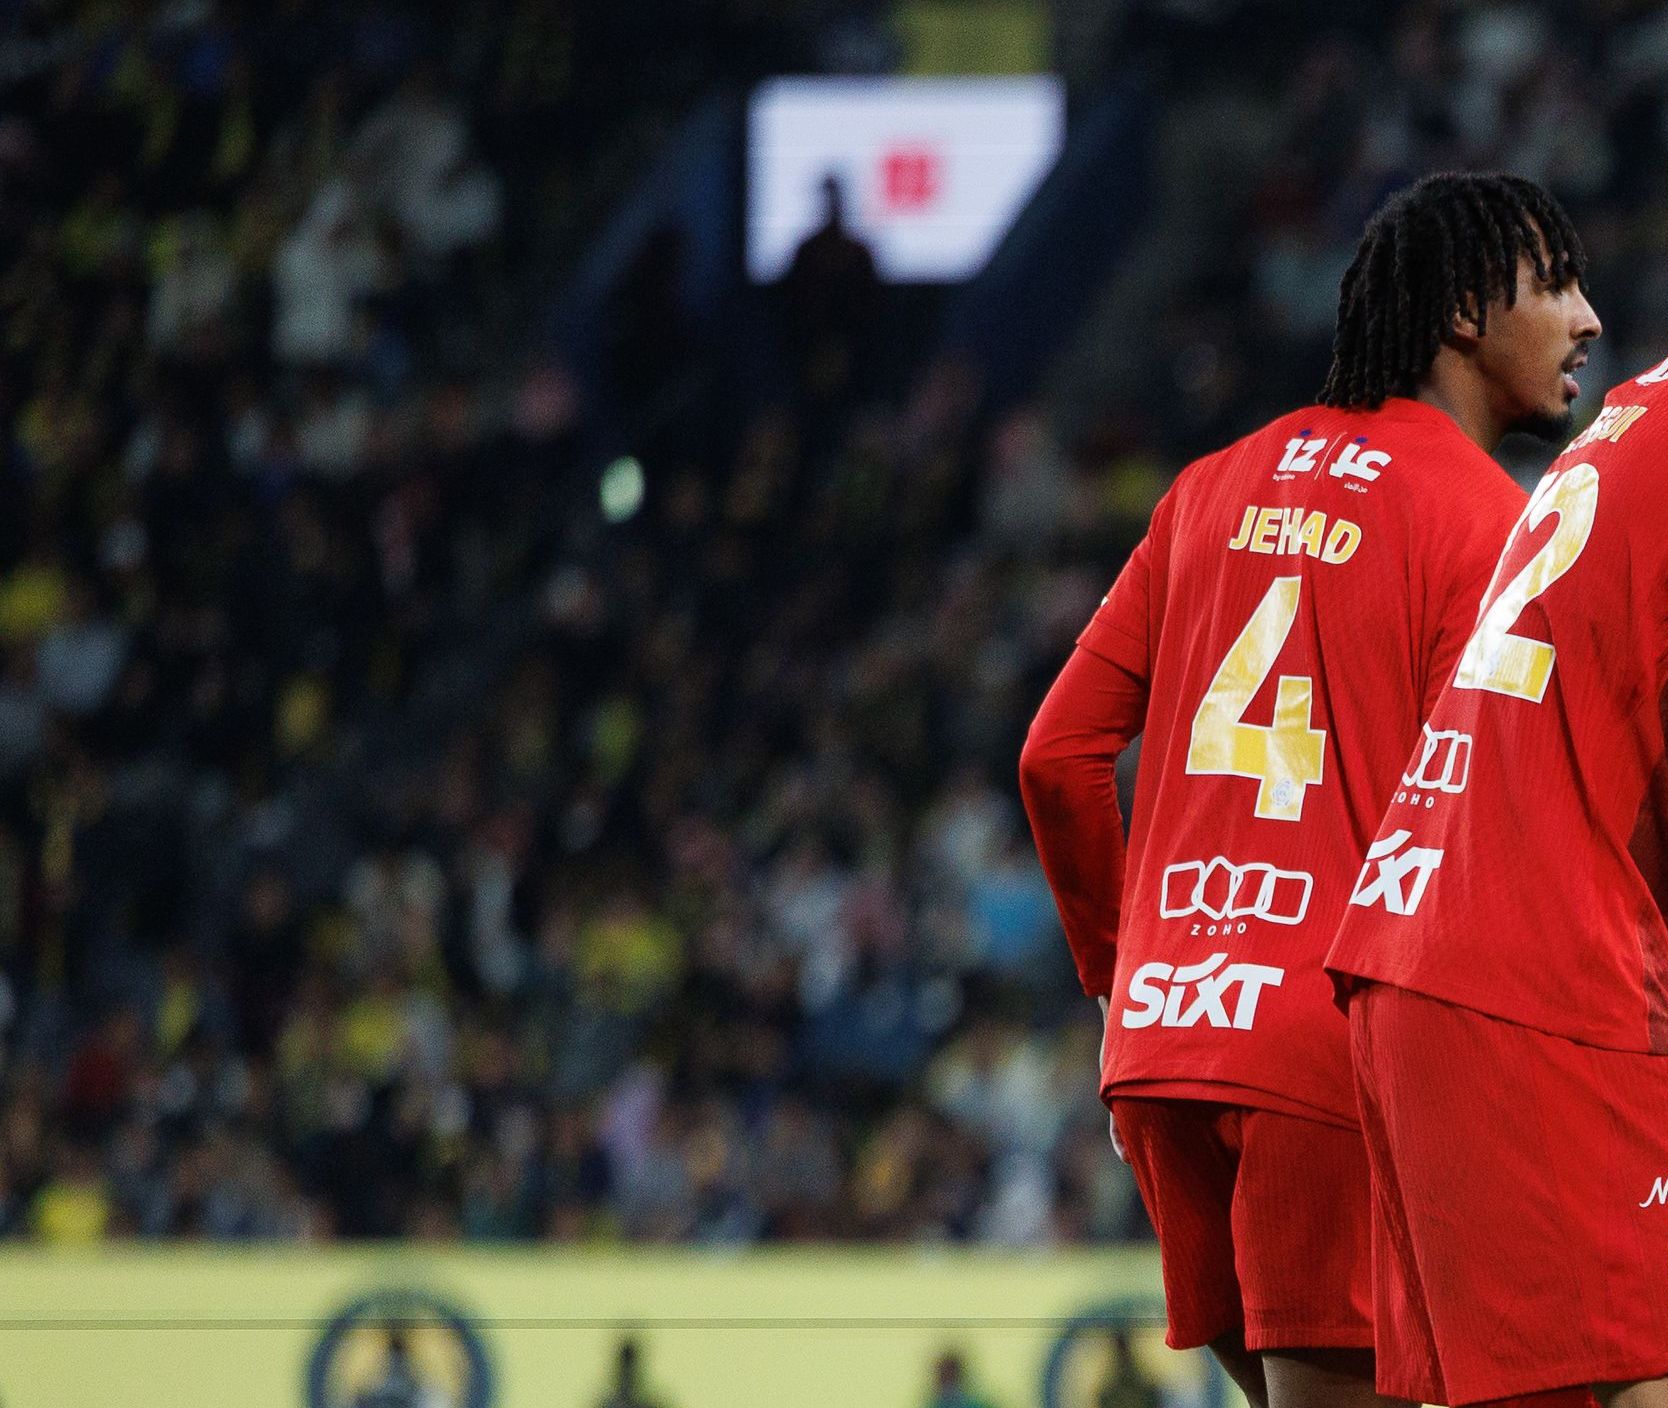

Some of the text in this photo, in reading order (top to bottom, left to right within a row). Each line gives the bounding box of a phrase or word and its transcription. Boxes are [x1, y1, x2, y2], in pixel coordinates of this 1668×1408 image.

[1229, 505, 1362, 565] JEHAD
[1185, 575, 1327, 822] 4
[1190, 922, 1247, 936] ZOHO
